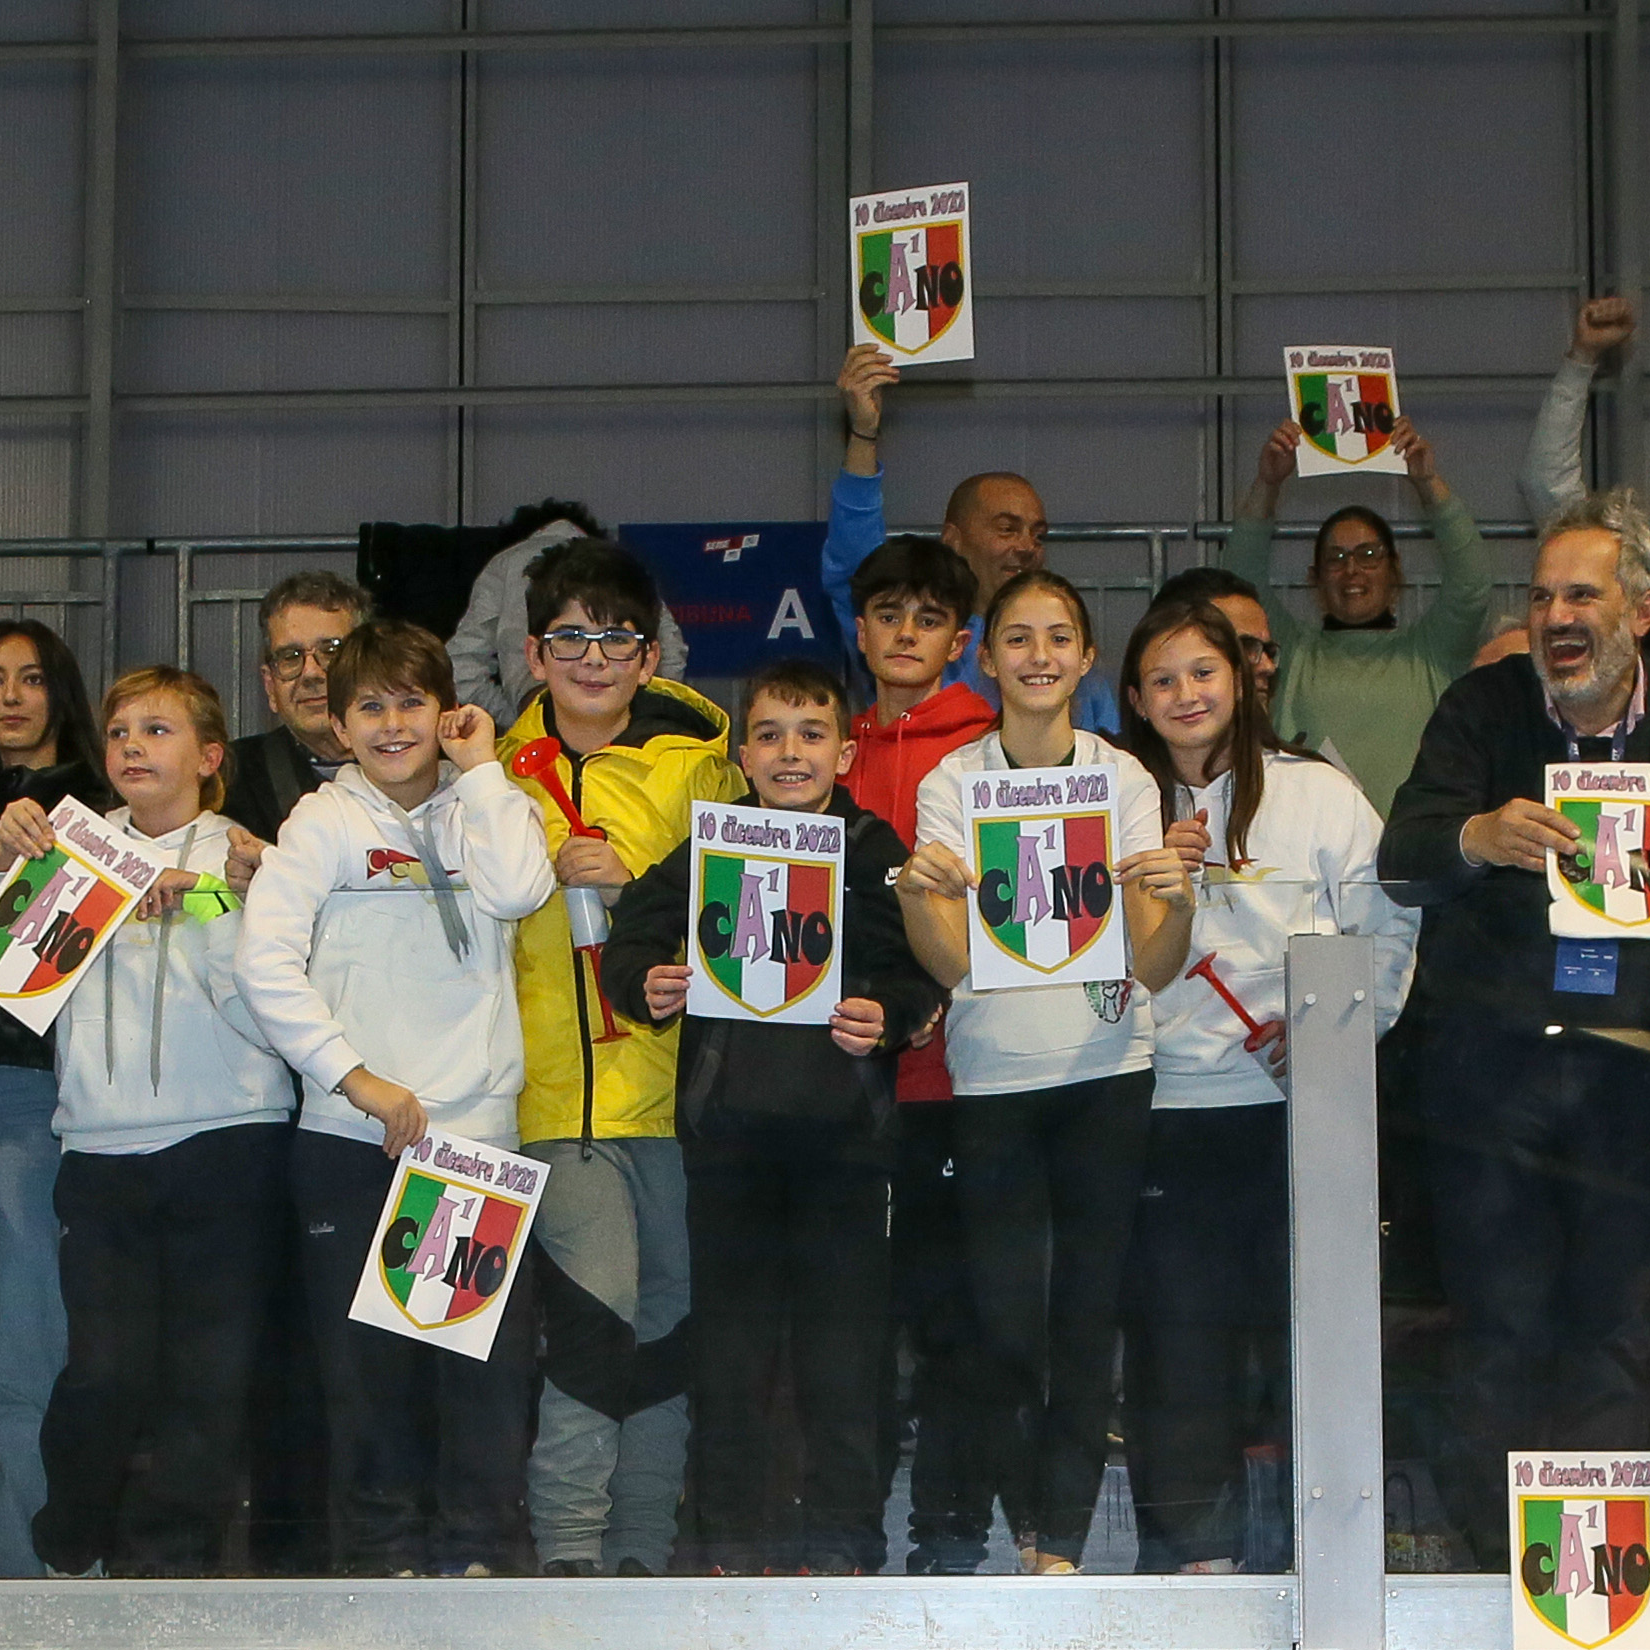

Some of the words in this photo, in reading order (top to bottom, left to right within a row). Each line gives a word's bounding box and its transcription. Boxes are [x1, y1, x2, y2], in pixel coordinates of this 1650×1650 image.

[854, 202, 869, 225] 10
[873, 196, 926, 222] dicembre
[930, 188, 965, 216] 2022
[675, 605, 752, 623] IBUNA
[767, 588, 815, 639] A
[972, 780, 990, 809] 10
[996, 777, 1062, 807] dicembre
[1065, 773, 1108, 804] 2022
[1551, 770, 1571, 791] 10
[1577, 770, 1646, 792] dicembre
[51, 806, 75, 830] 10
[112, 851, 156, 890] 2022
[697, 811, 716, 840] 10
[722, 814, 791, 849] dicembre
[795, 822, 840, 854] 2022
[412, 1134, 434, 1162] 10
[434, 1140, 495, 1182] dicembre
[494, 1160, 539, 1195] 2022
[1514, 1460, 1533, 1486] 10
[1539, 1460, 1606, 1486] dicembre
